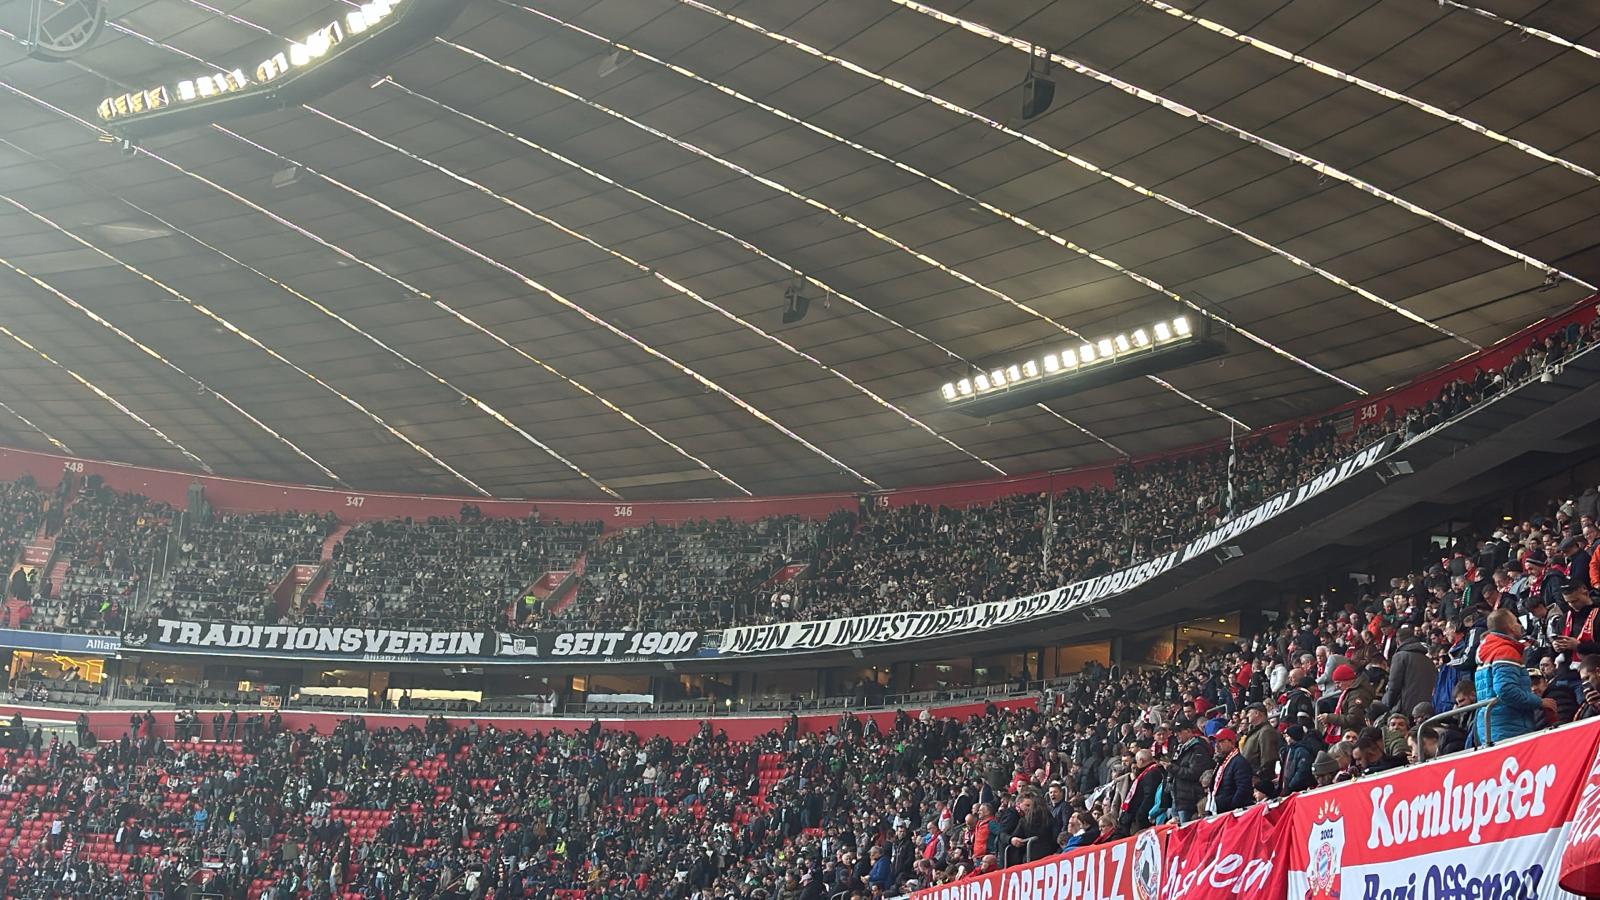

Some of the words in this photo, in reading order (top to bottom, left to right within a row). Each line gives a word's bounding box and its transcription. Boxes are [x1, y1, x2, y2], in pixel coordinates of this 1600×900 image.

[1360, 404, 1377, 420] 343
[63, 461, 84, 473] 348
[345, 496, 365, 507] 347
[613, 506, 633, 517] 346
[729, 625, 790, 651] NEIN
[794, 621, 831, 648] ZU
[834, 606, 976, 645] INVESTOREN
[86, 639, 121, 650] Allianz
[157, 618, 485, 656] TRADITIONSVEREIN
[551, 632, 627, 656] SEIT
[624, 631, 699, 656] 1900
[1367, 756, 1556, 849] Kornlupfer
